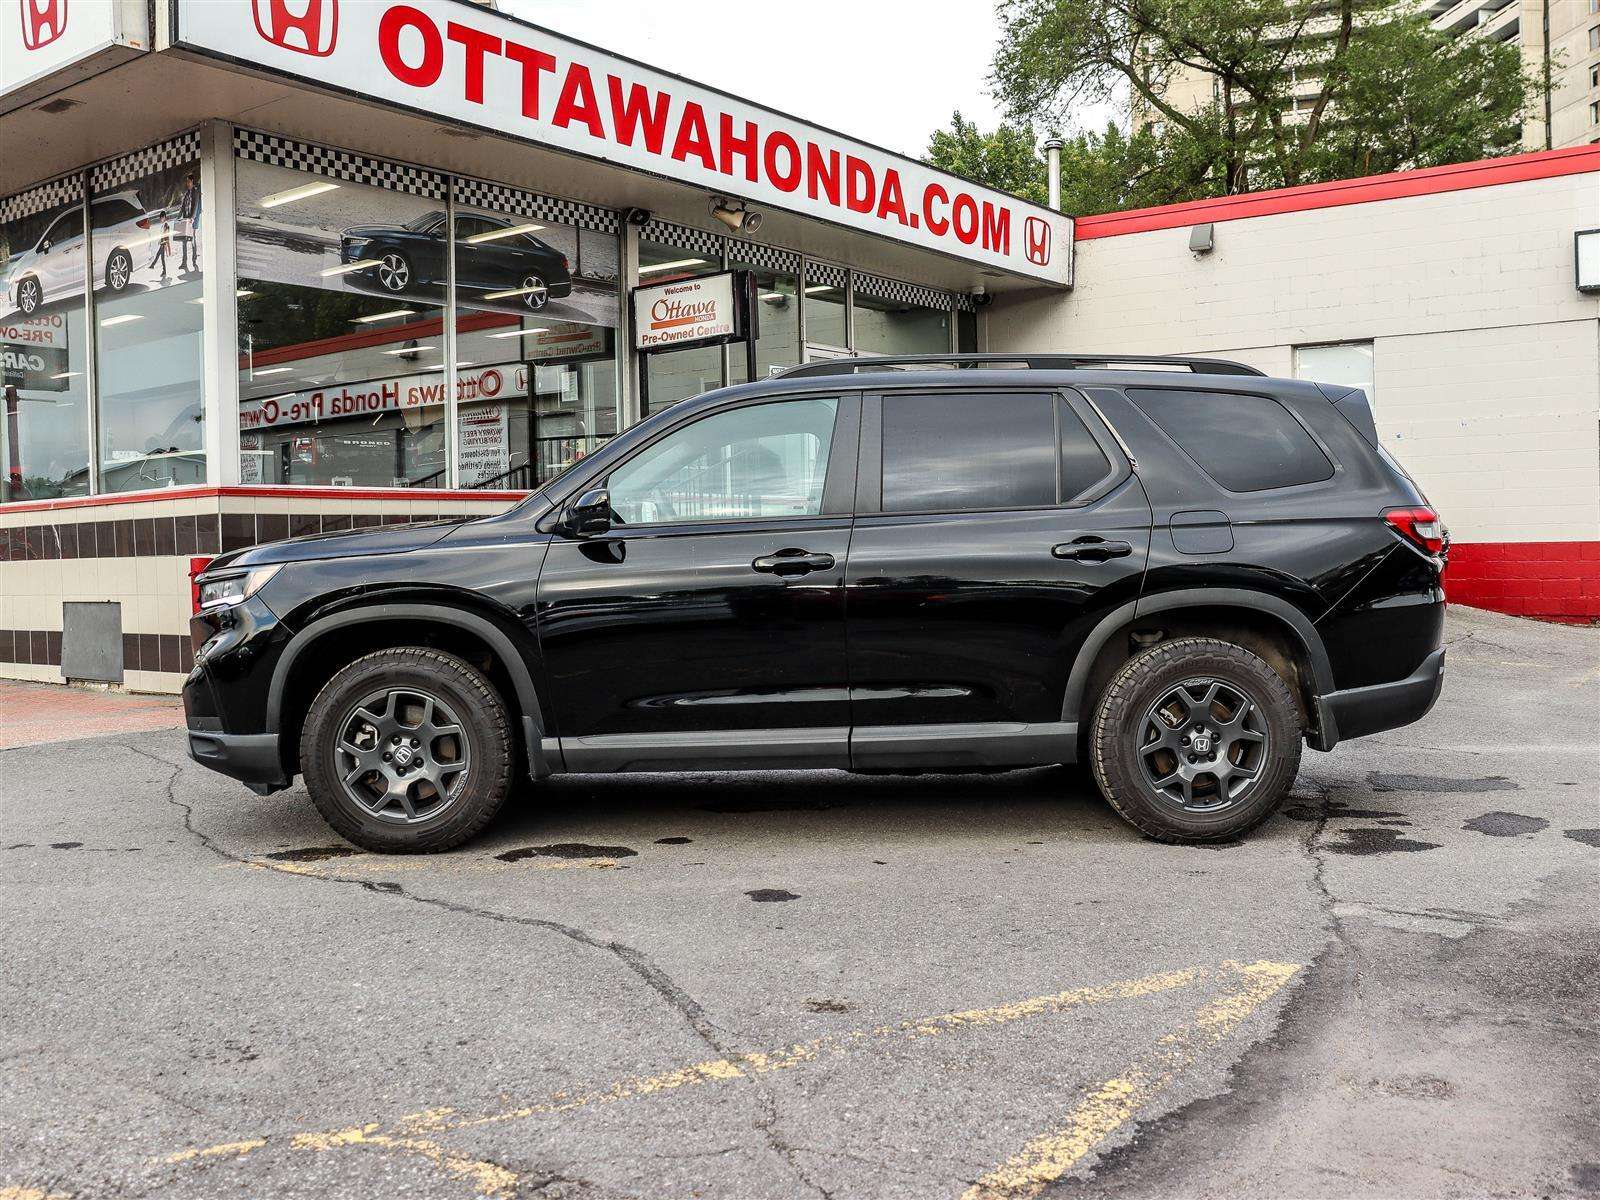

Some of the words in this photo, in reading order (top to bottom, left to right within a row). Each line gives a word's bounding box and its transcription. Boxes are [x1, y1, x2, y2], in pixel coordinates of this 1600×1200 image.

[378, 5, 1011, 256] OTTAWAHONDA.COM
[664, 285, 693, 295] Welcome
[651, 297, 717, 321] Ottawa
[694, 313, 716, 323] HONDA
[642, 326, 695, 345] Pre-Owned
[697, 324, 730, 336] Centre
